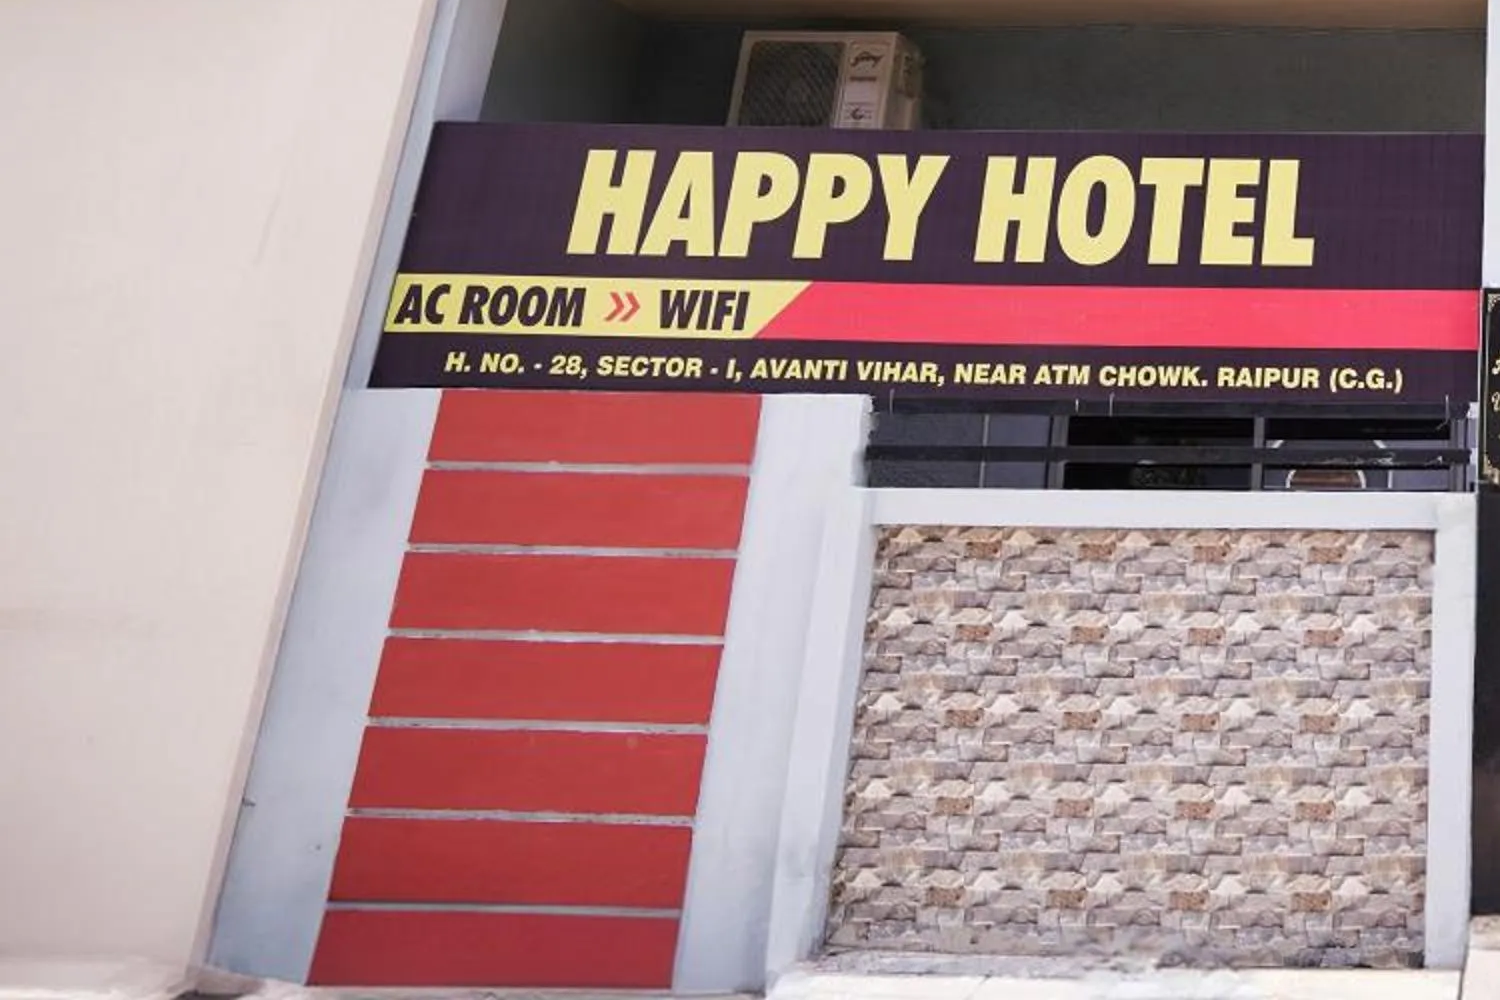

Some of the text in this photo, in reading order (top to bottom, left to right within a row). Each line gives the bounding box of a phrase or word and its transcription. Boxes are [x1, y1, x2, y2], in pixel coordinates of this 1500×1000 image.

[566, 149, 1315, 267] HAPPY HOTEL
[394, 283, 750, 330] AC ROOM WIFI
[444, 351, 471, 372] H.
[479, 352, 525, 374] NO.
[549, 354, 587, 379] 28,
[596, 355, 703, 378] SECTOR
[749, 358, 849, 381] AVANTI
[857, 360, 945, 387] VIHAR,
[953, 363, 1027, 385] NEAR
[1033, 364, 1091, 385] ATM
[1099, 365, 1208, 387] CHOWK.
[1217, 367, 1320, 389] RAIPUR
[1329, 367, 1403, 394] (C.G.)
